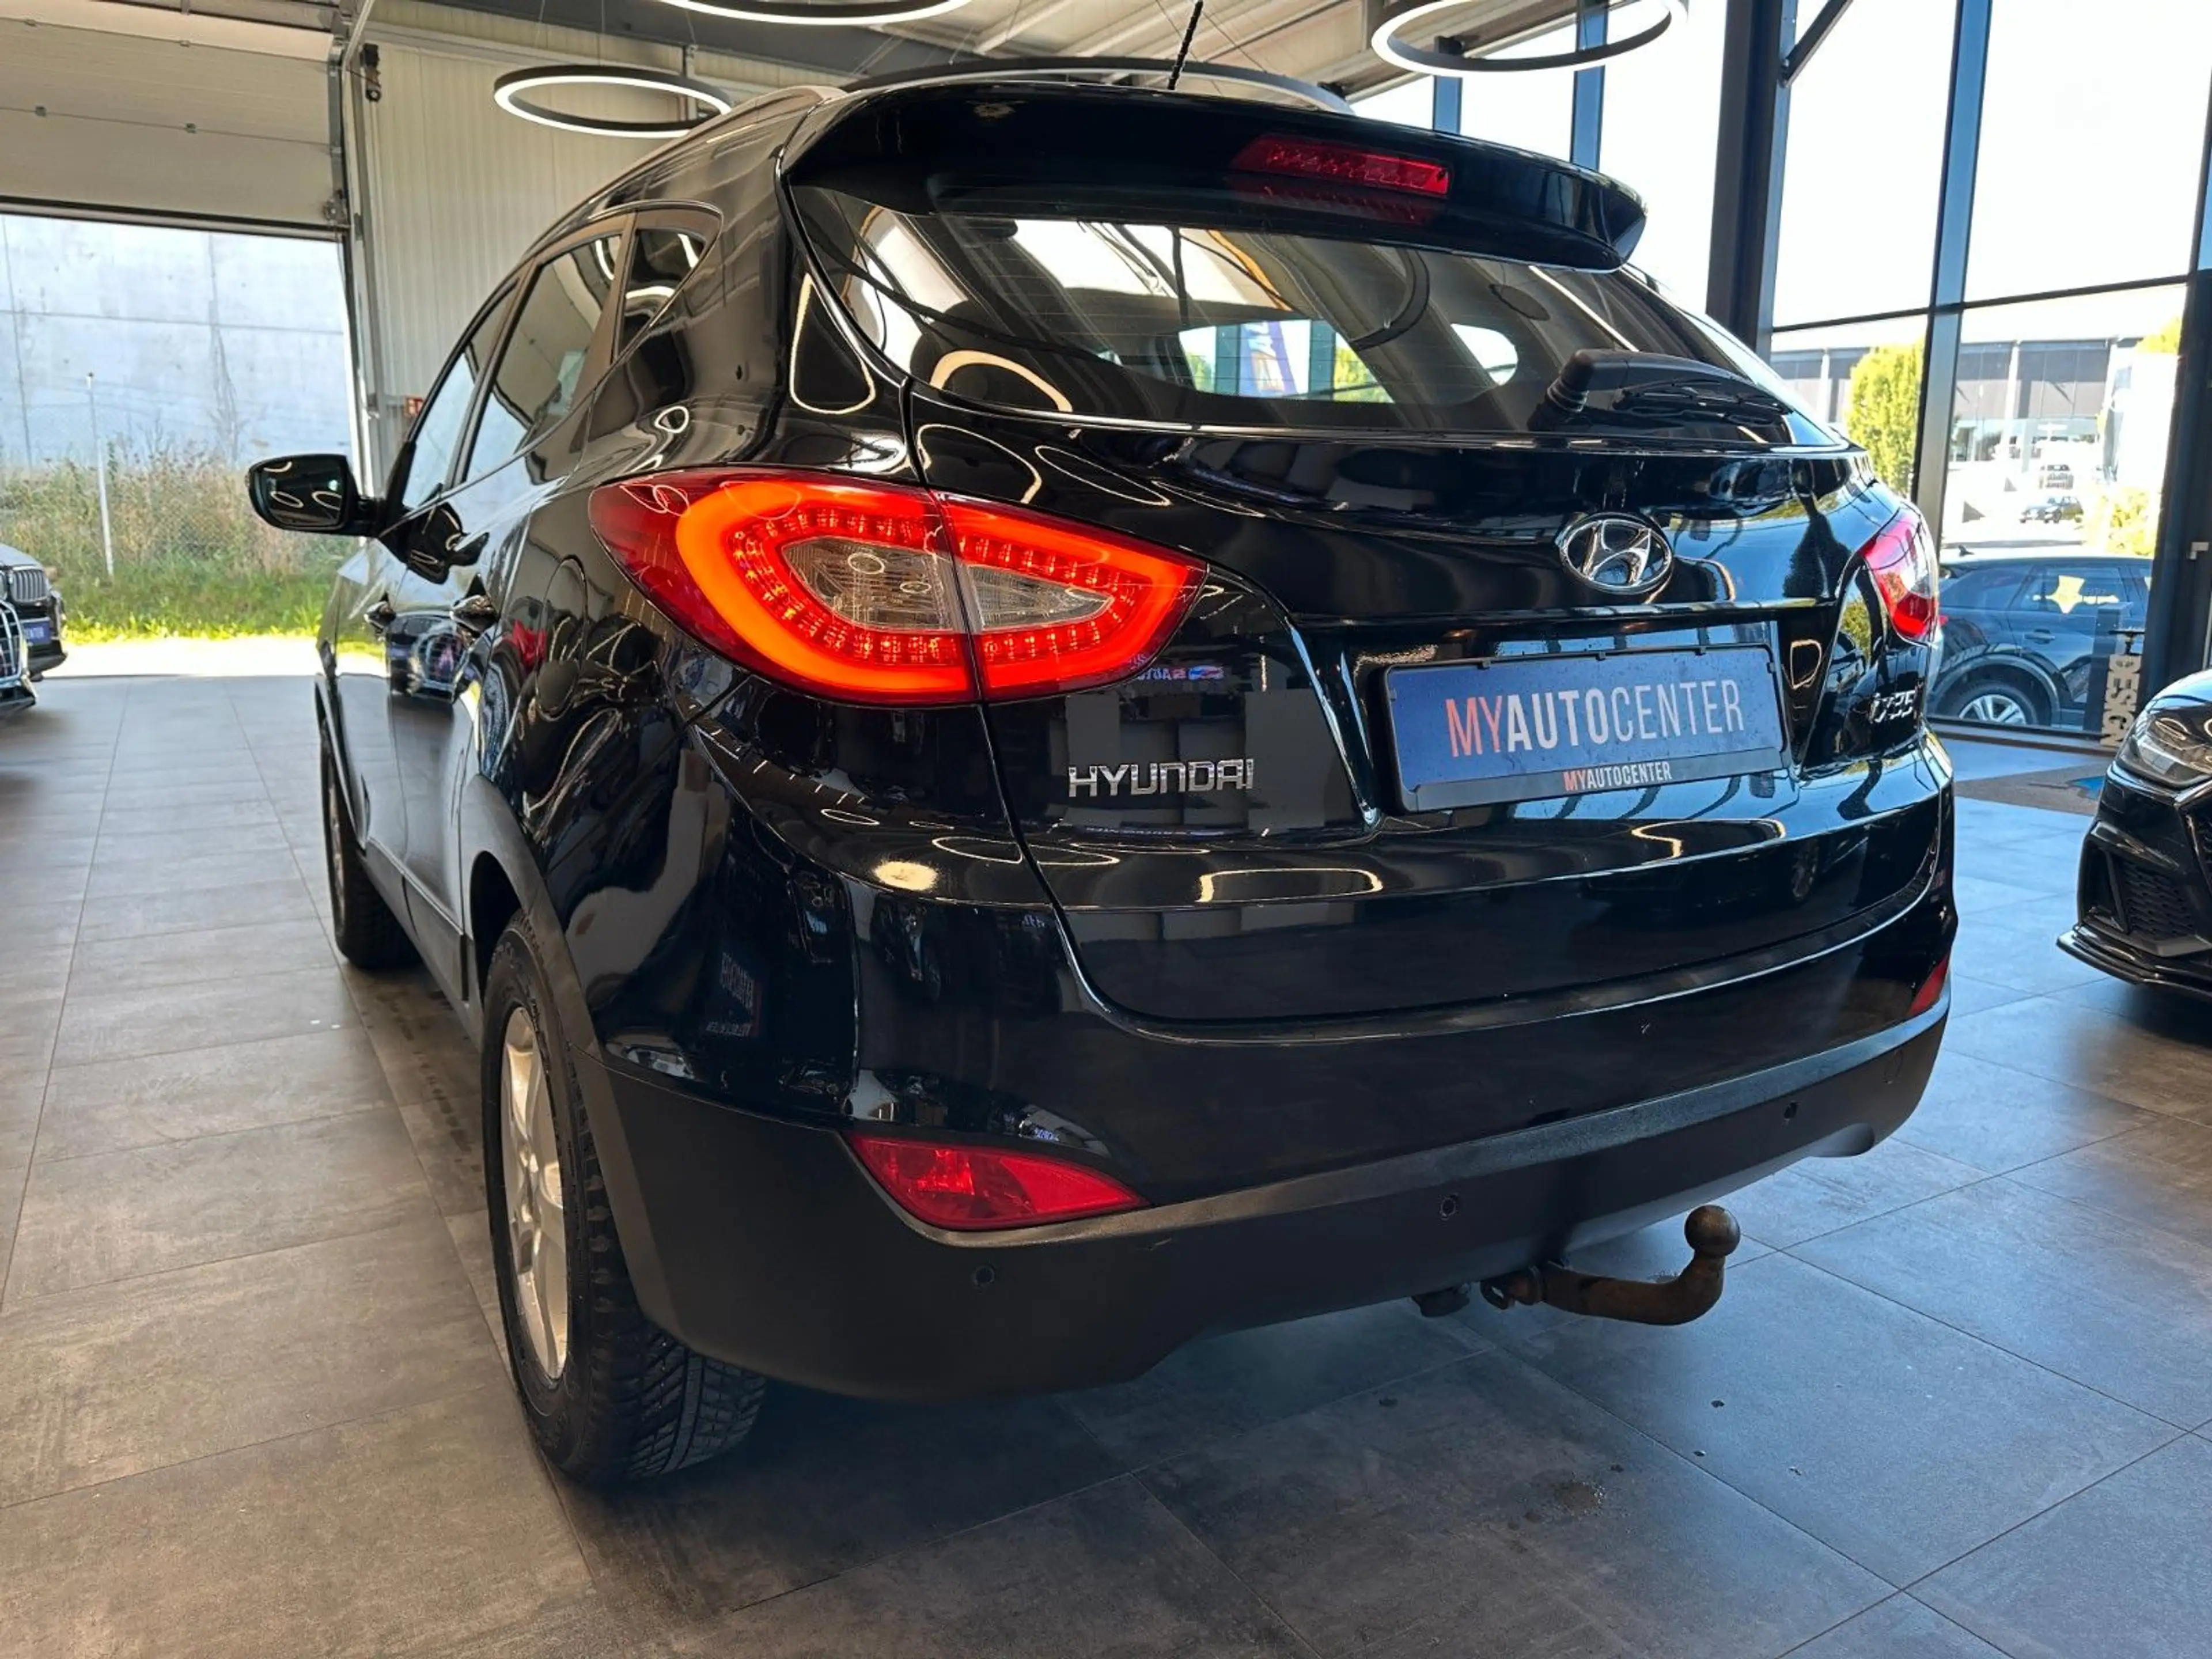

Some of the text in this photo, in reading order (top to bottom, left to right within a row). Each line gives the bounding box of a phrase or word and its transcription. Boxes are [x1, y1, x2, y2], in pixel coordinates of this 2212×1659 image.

[1446, 679, 1744, 757] MYAUTOCENTER
[1069, 759, 1253, 797] HYUNDAI
[1563, 761, 1672, 791] MYAUTOCENTER
